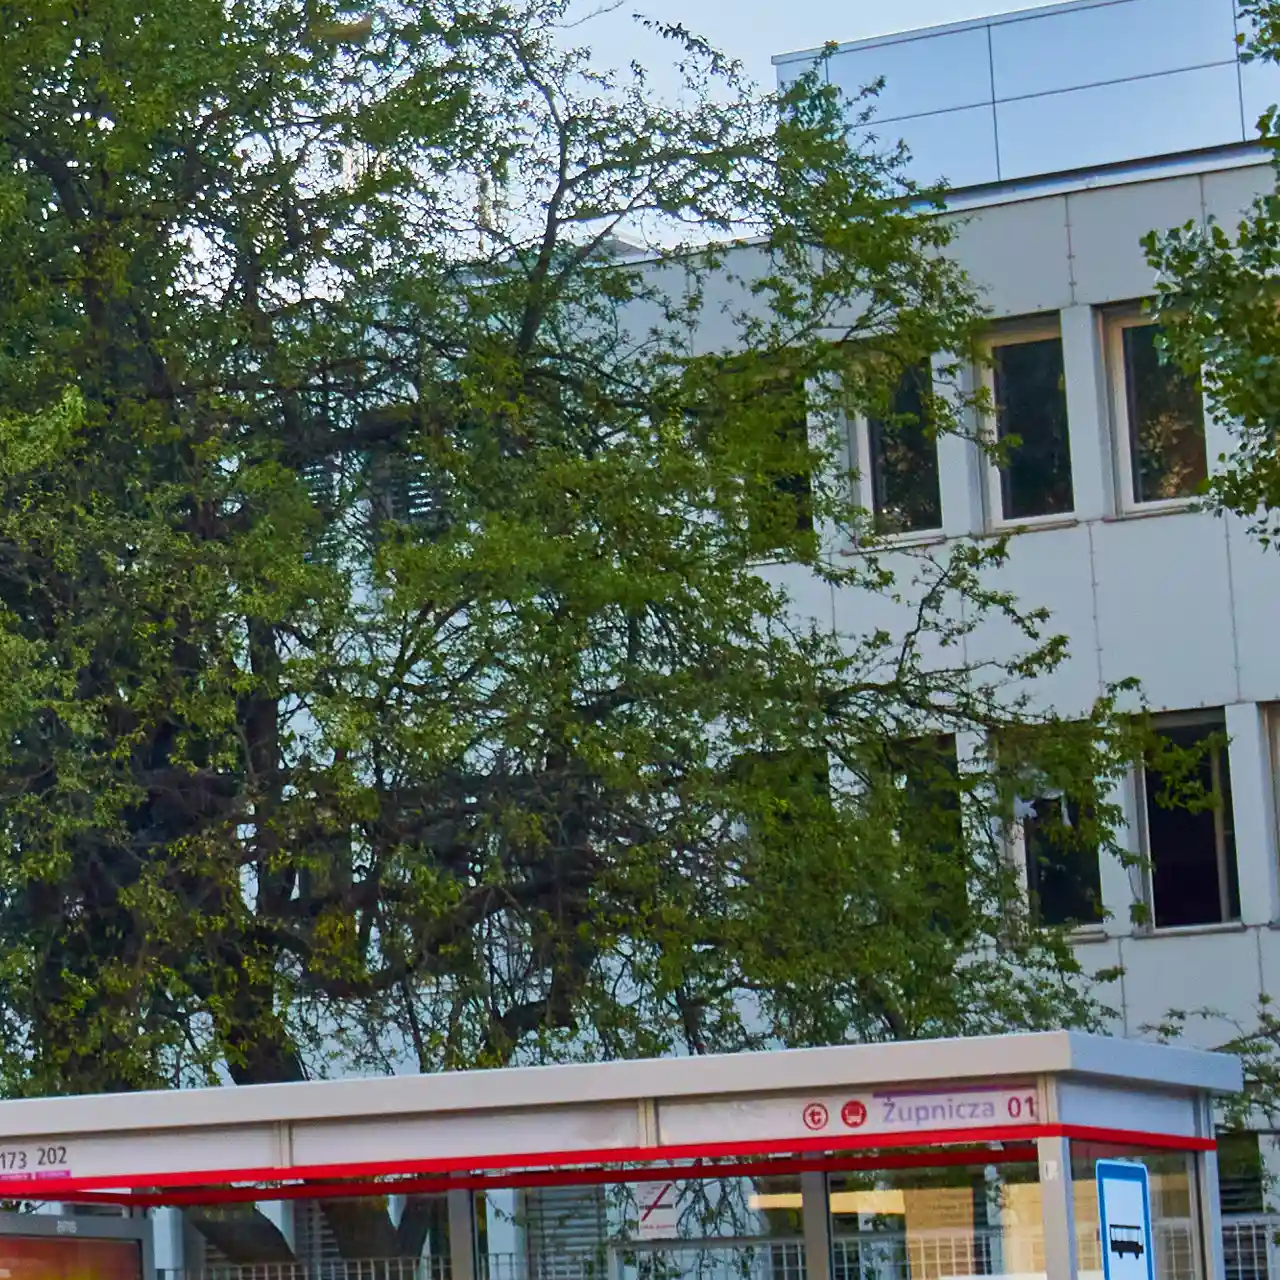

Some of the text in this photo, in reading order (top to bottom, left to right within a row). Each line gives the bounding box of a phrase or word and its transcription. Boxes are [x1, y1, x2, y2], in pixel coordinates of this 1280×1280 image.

[882, 1095, 1035, 1125] Żupnicza 01
[0, 1150, 27, 1170] 173
[37, 1145, 67, 1166] 202
